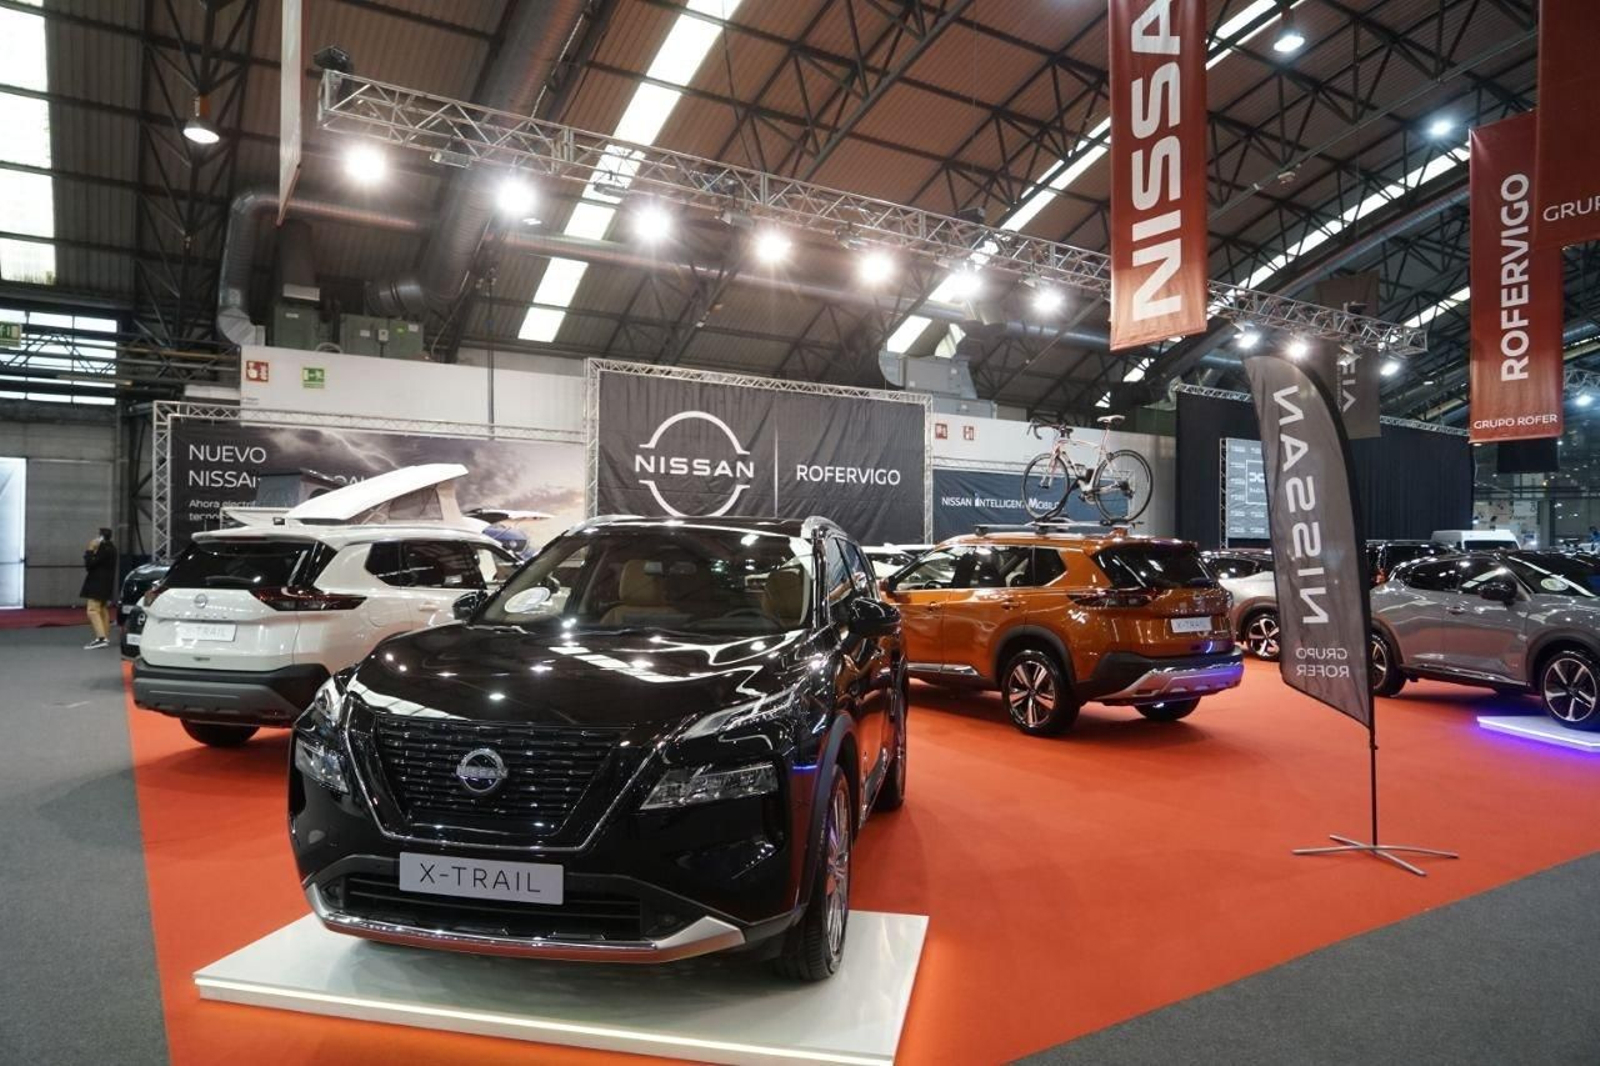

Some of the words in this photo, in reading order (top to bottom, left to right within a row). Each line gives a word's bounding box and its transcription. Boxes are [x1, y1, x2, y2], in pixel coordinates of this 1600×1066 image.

[1501, 173, 1529, 382] ROFERVIGO
[1473, 418, 1515, 429] GRUPO
[1517, 414, 1558, 426] ROFER
[189, 444, 267, 464] NUEVO
[634, 455, 755, 478] NISSAN
[797, 464, 900, 486] ROFERVIGO
[941, 497, 972, 507] NISSAN
[974, 491, 1025, 509] INTELLIGEN
[420, 863, 541, 893] X-TRAIL
